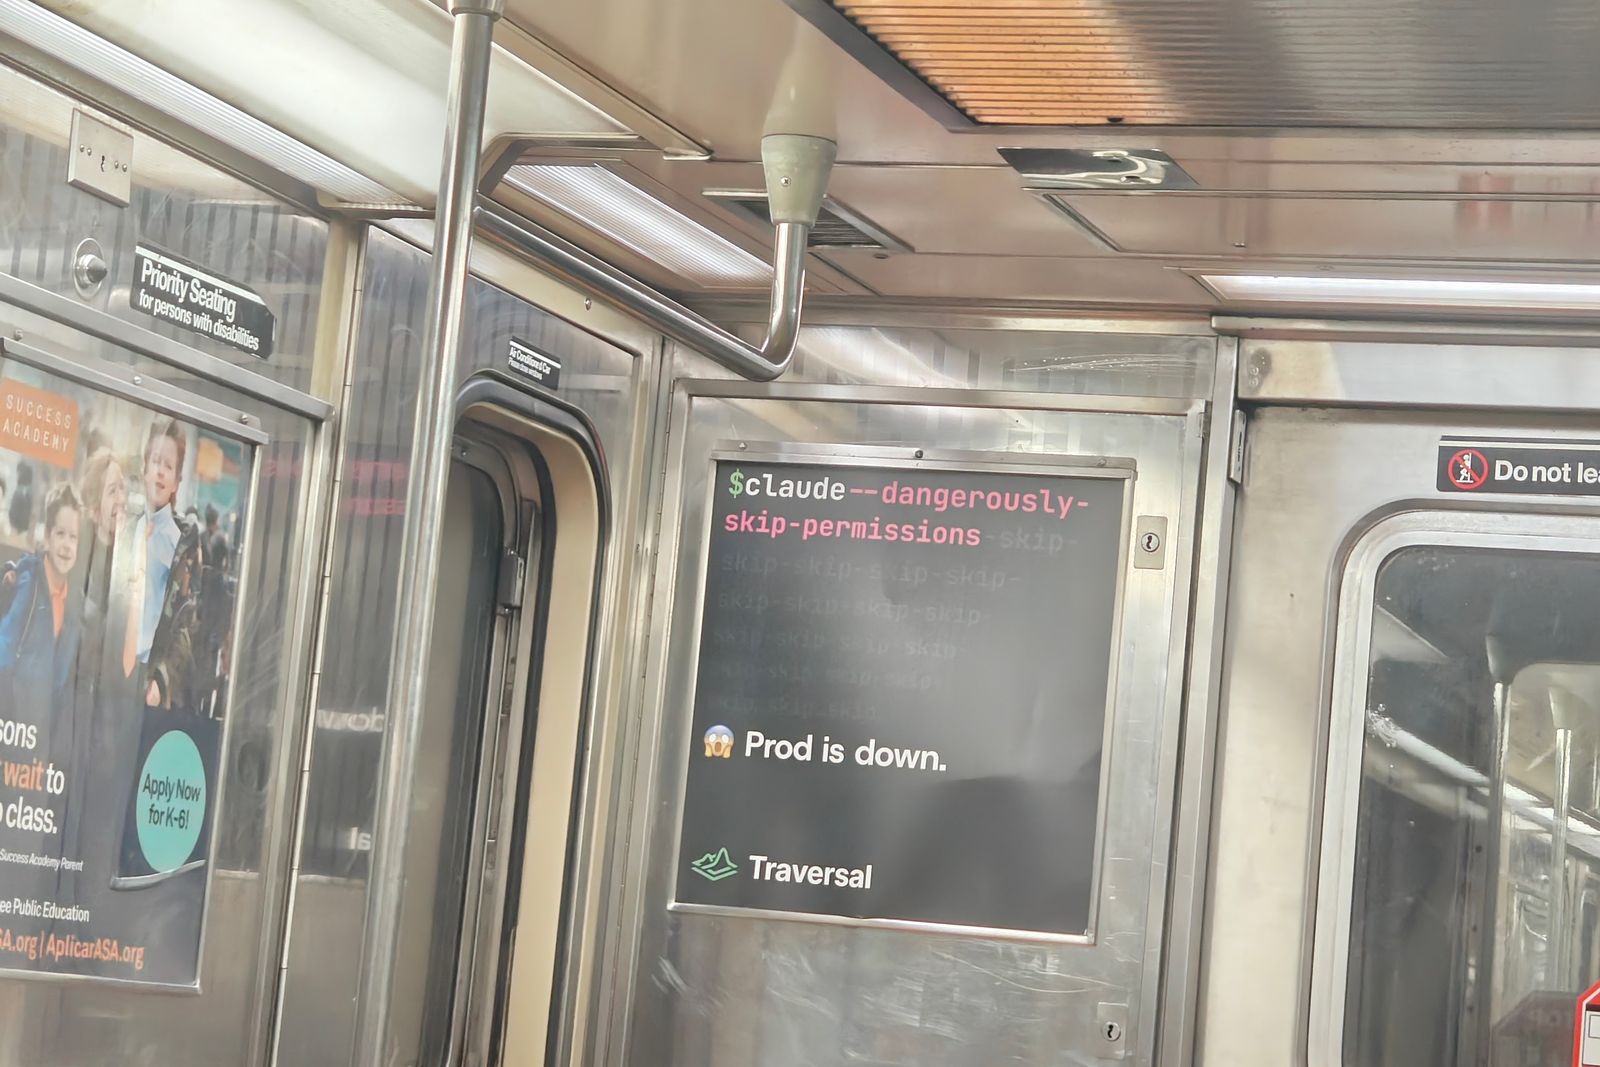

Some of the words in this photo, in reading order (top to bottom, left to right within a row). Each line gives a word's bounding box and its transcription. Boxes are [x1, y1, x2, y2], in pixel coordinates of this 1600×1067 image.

[141, 258, 189, 303] Priority
[189, 278, 237, 323] Seating
[139, 288, 154, 309] for
[153, 297, 192, 325] persons
[193, 312, 212, 333] with
[213, 319, 260, 351] disabilities
[6, 394, 71, 430] SUCCESS
[2, 417, 69, 453] ACADEMY
[1494, 460, 1528, 481] Do
[1531, 463, 1571, 483] not
[1577, 462, 1600, 483] le
[744, 730, 813, 761] Prod
[822, 735, 845, 763] is
[855, 739, 947, 771] down.
[4, 757, 44, 791] wait
[46, 763, 65, 795] to
[142, 773, 175, 803] Apply
[175, 778, 201, 802] Now
[6, 796, 58, 834] class.
[148, 803, 165, 826] for
[165, 806, 190, 830] K-6!
[0, 848, 28, 864] Success
[29, 853, 61, 872] Academy
[60, 857, 84, 872] Parent
[749, 855, 873, 889] Traversal
[13, 897, 41, 917] Public
[42, 901, 90, 923] Education
[0, 927, 38, 960] A.org
[46, 933, 145, 971] AplicarASA.org
